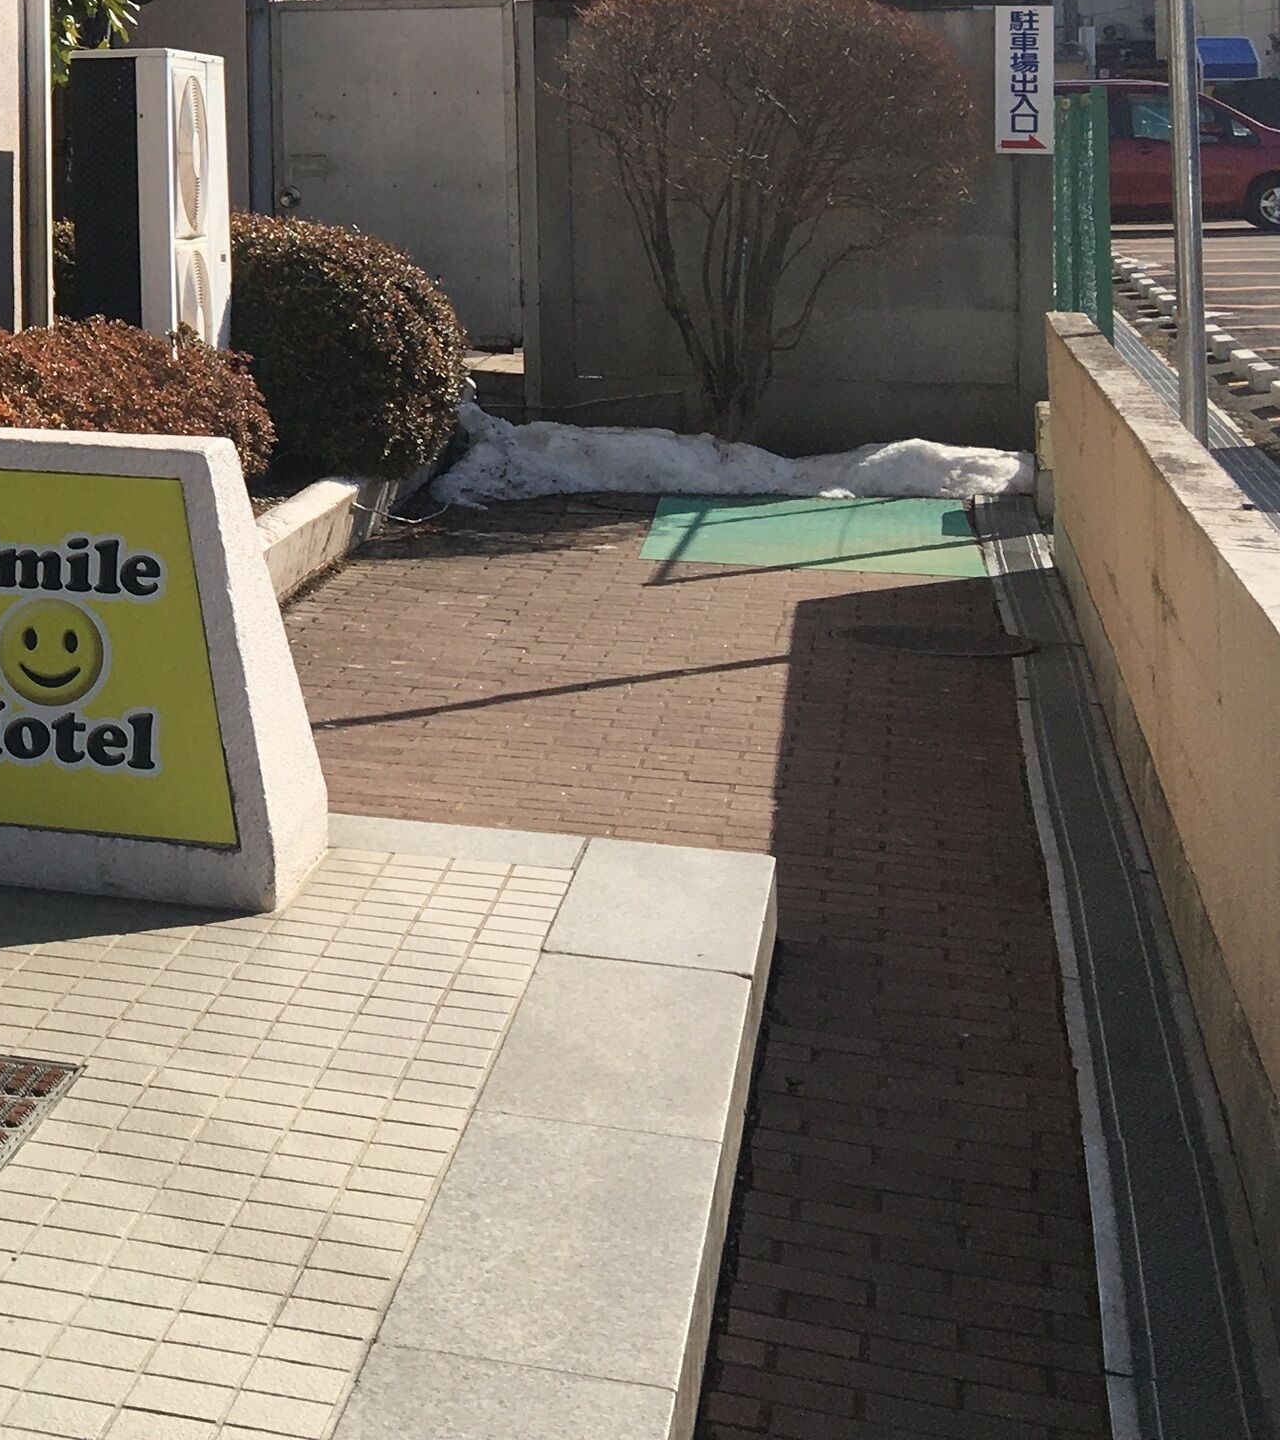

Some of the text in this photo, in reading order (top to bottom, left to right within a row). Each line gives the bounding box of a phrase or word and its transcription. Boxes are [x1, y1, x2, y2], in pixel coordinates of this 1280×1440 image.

[1009, 9, 1040, 134] 駐車場出入口
